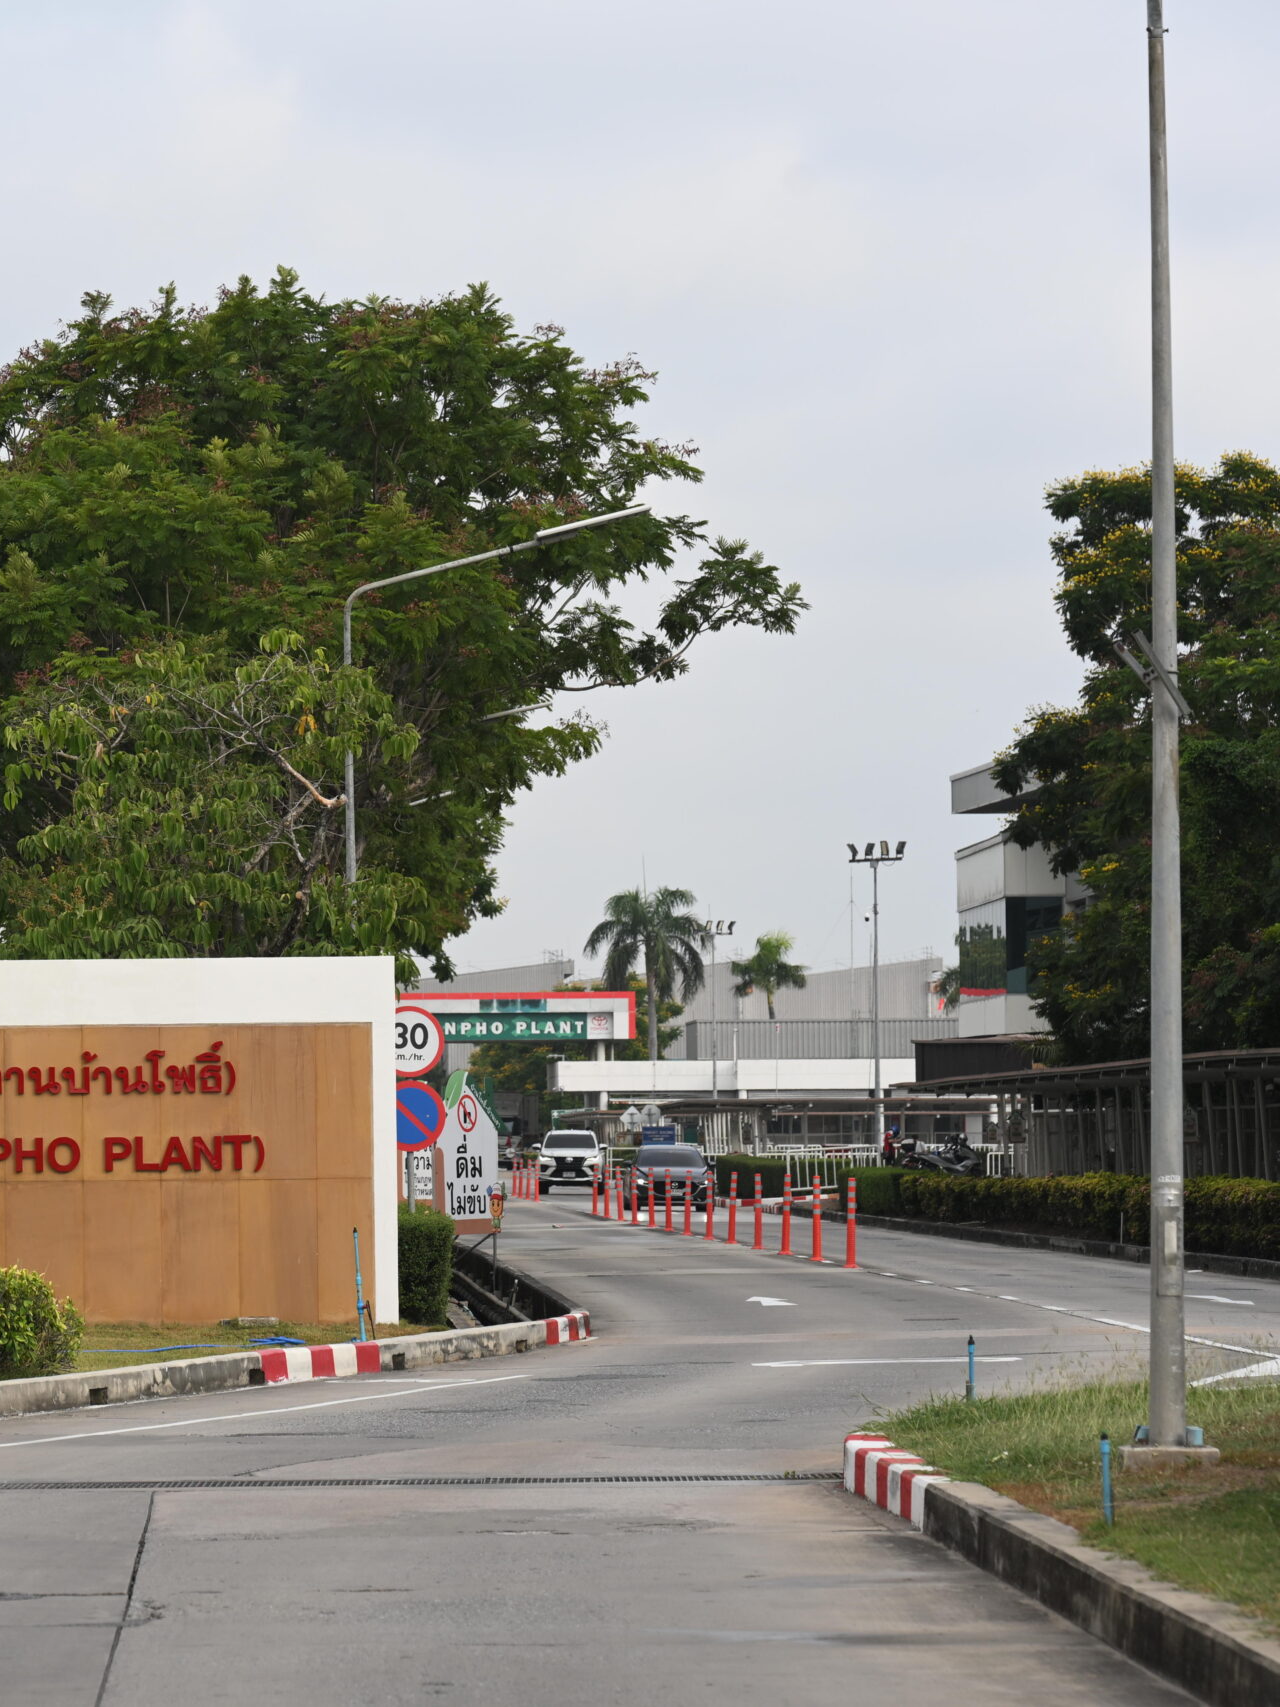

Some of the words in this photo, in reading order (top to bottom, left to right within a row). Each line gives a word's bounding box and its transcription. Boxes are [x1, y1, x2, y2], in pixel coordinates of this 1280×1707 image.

[394, 1022, 429, 1050] 30
[516, 1020, 585, 1035] PLANT
[394, 1052, 426, 1061] m./hr.
[103, 1134, 266, 1173] PLANT)
[455, 1134, 483, 1178] ดื่ม
[446, 1181, 487, 1216] ไม่ขับ
